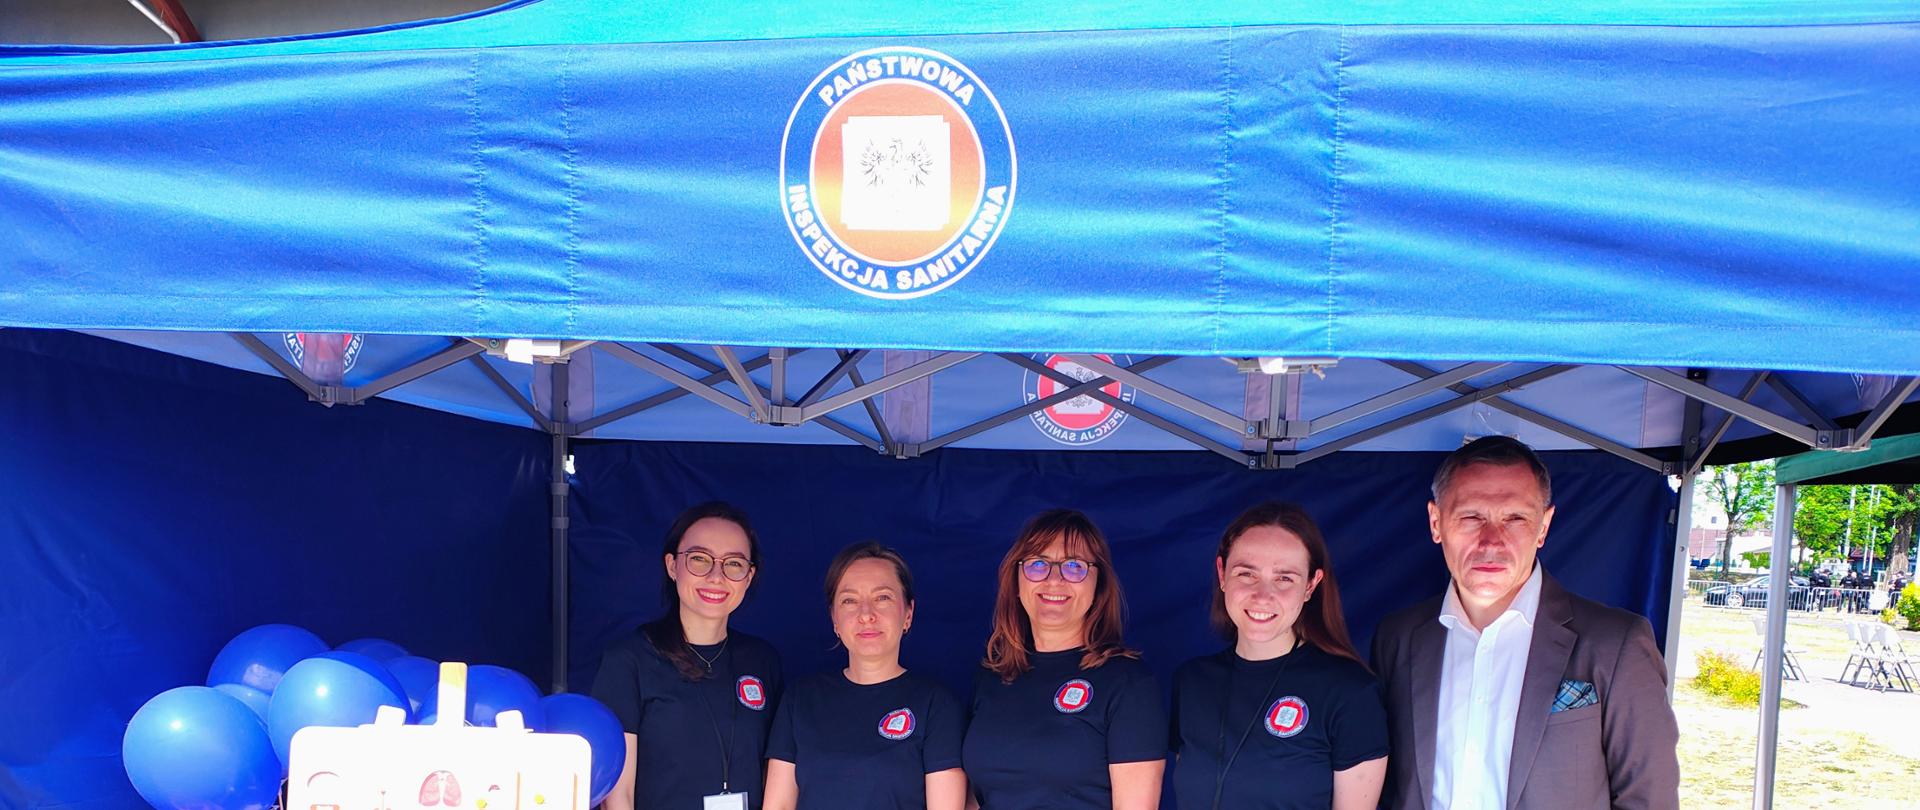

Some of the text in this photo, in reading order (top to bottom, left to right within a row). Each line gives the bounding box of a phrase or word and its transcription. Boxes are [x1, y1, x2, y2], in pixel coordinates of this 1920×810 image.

[818, 56, 975, 106] PAŃSTWOWA
[788, 184, 1007, 290] INSPEKCJA SANITARNA
